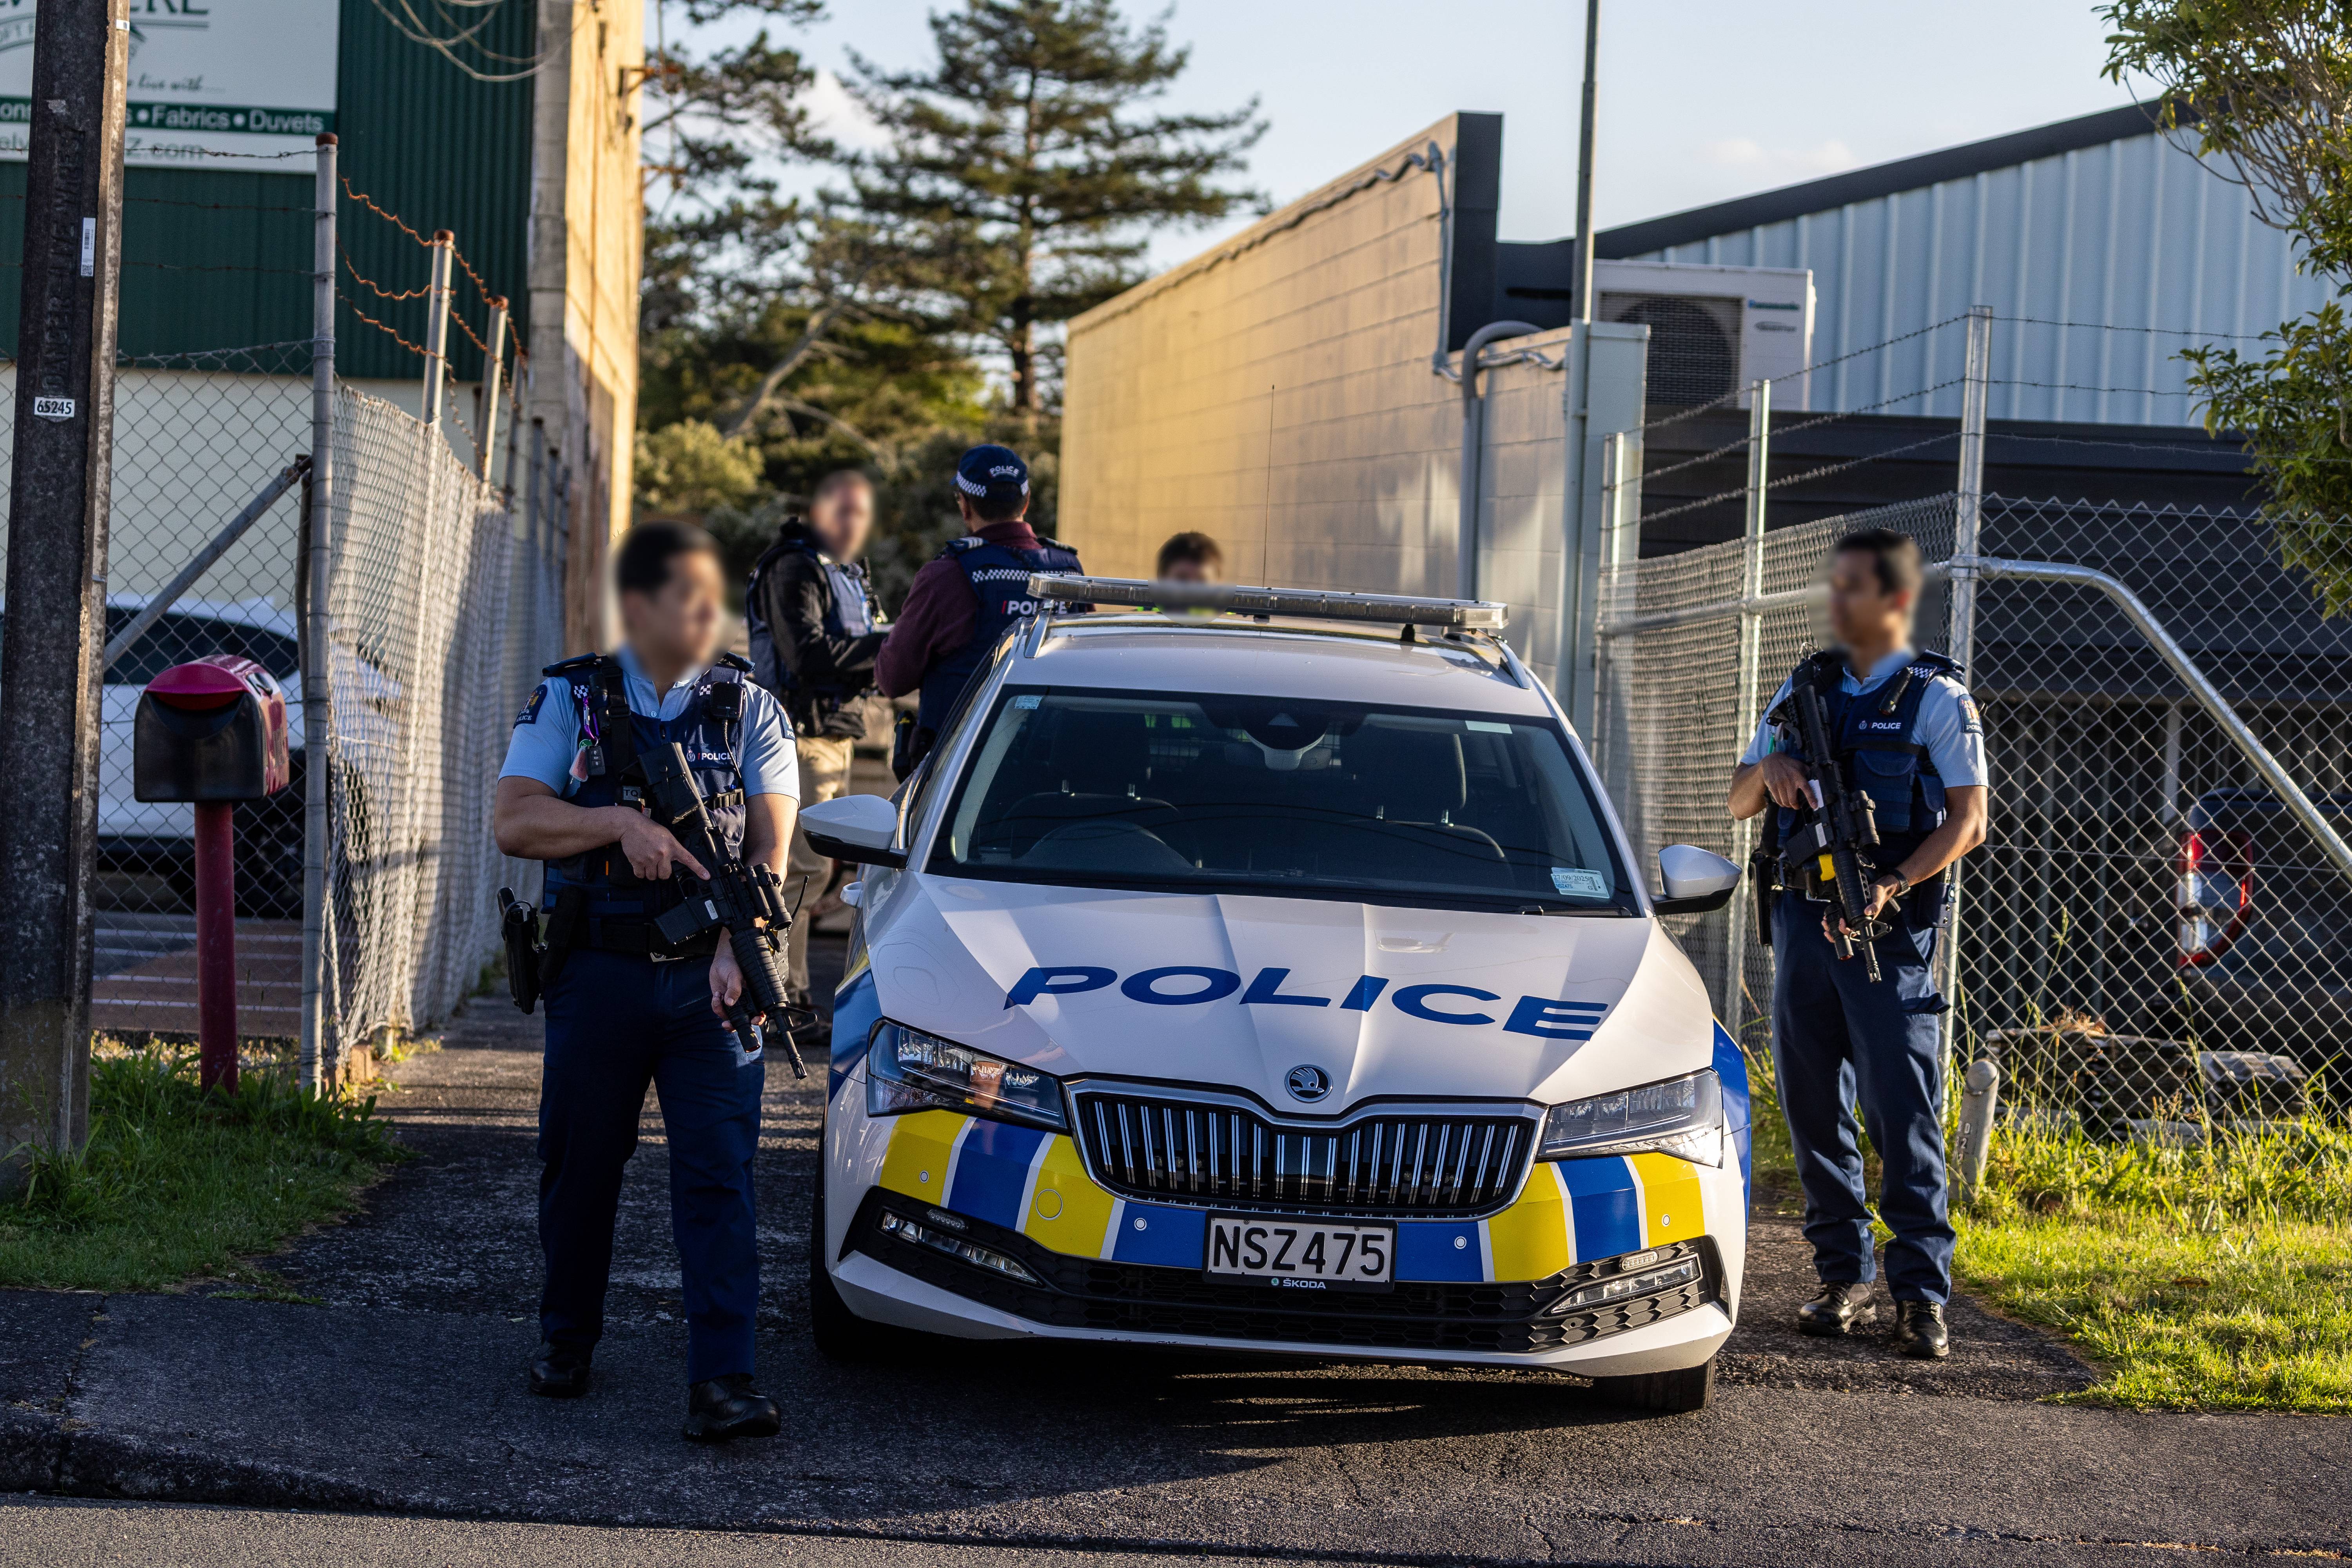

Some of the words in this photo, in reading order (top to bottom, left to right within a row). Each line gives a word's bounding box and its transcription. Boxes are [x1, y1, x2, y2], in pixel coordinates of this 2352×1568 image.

[152, 105, 230, 129] Fabrics
[250, 109, 324, 134] Duvets
[37, 400, 72, 414] 65245
[989, 465, 1019, 475] POLICE
[624, 789, 639, 798] TQ
[1003, 965, 1608, 1042] POLICE
[1213, 1225, 1385, 1276] NSZ475
[1283, 1278, 1326, 1289] ŠKODA
